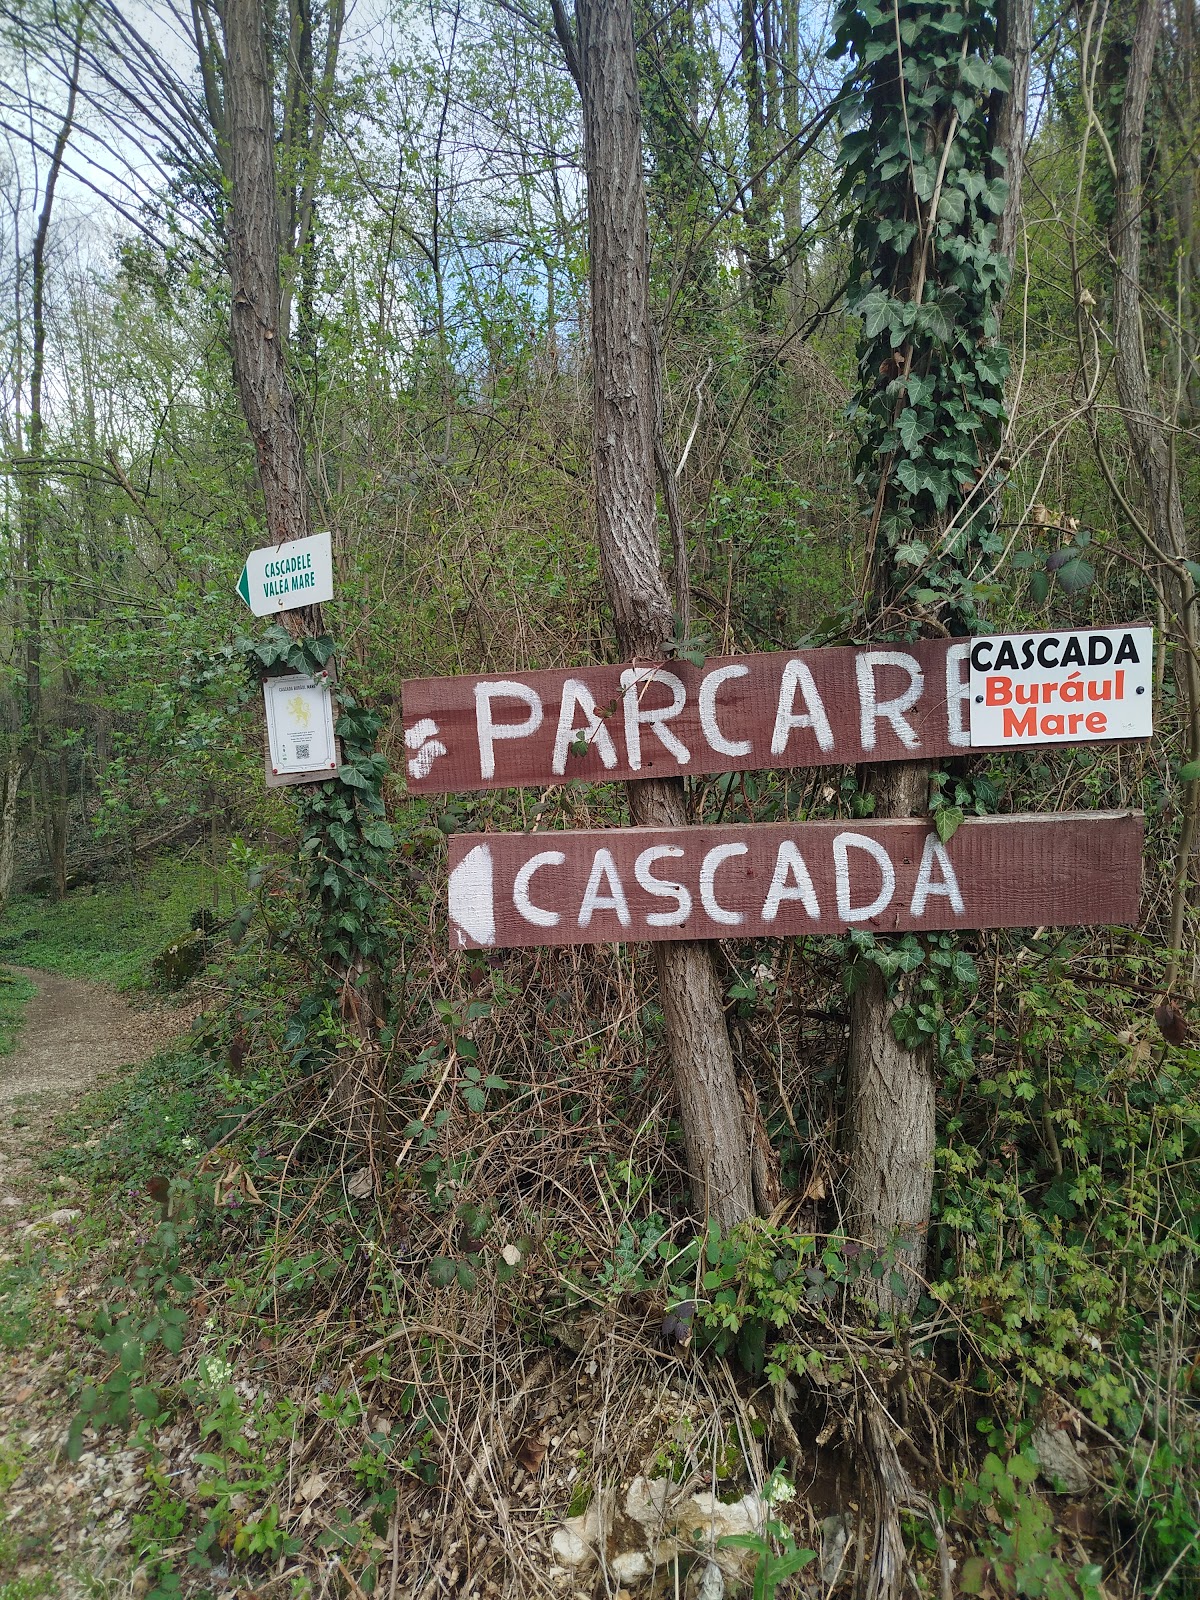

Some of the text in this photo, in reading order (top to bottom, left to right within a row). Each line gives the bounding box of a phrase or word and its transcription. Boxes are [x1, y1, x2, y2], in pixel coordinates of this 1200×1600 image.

[264, 553, 312, 578] CASCADELE
[263, 571, 315, 598] VALEA MARE
[971, 633, 1140, 672] CASCADA
[985, 670, 1125, 707] Burául
[1003, 706, 1108, 738] Mare
[513, 831, 966, 927] CASCADA
